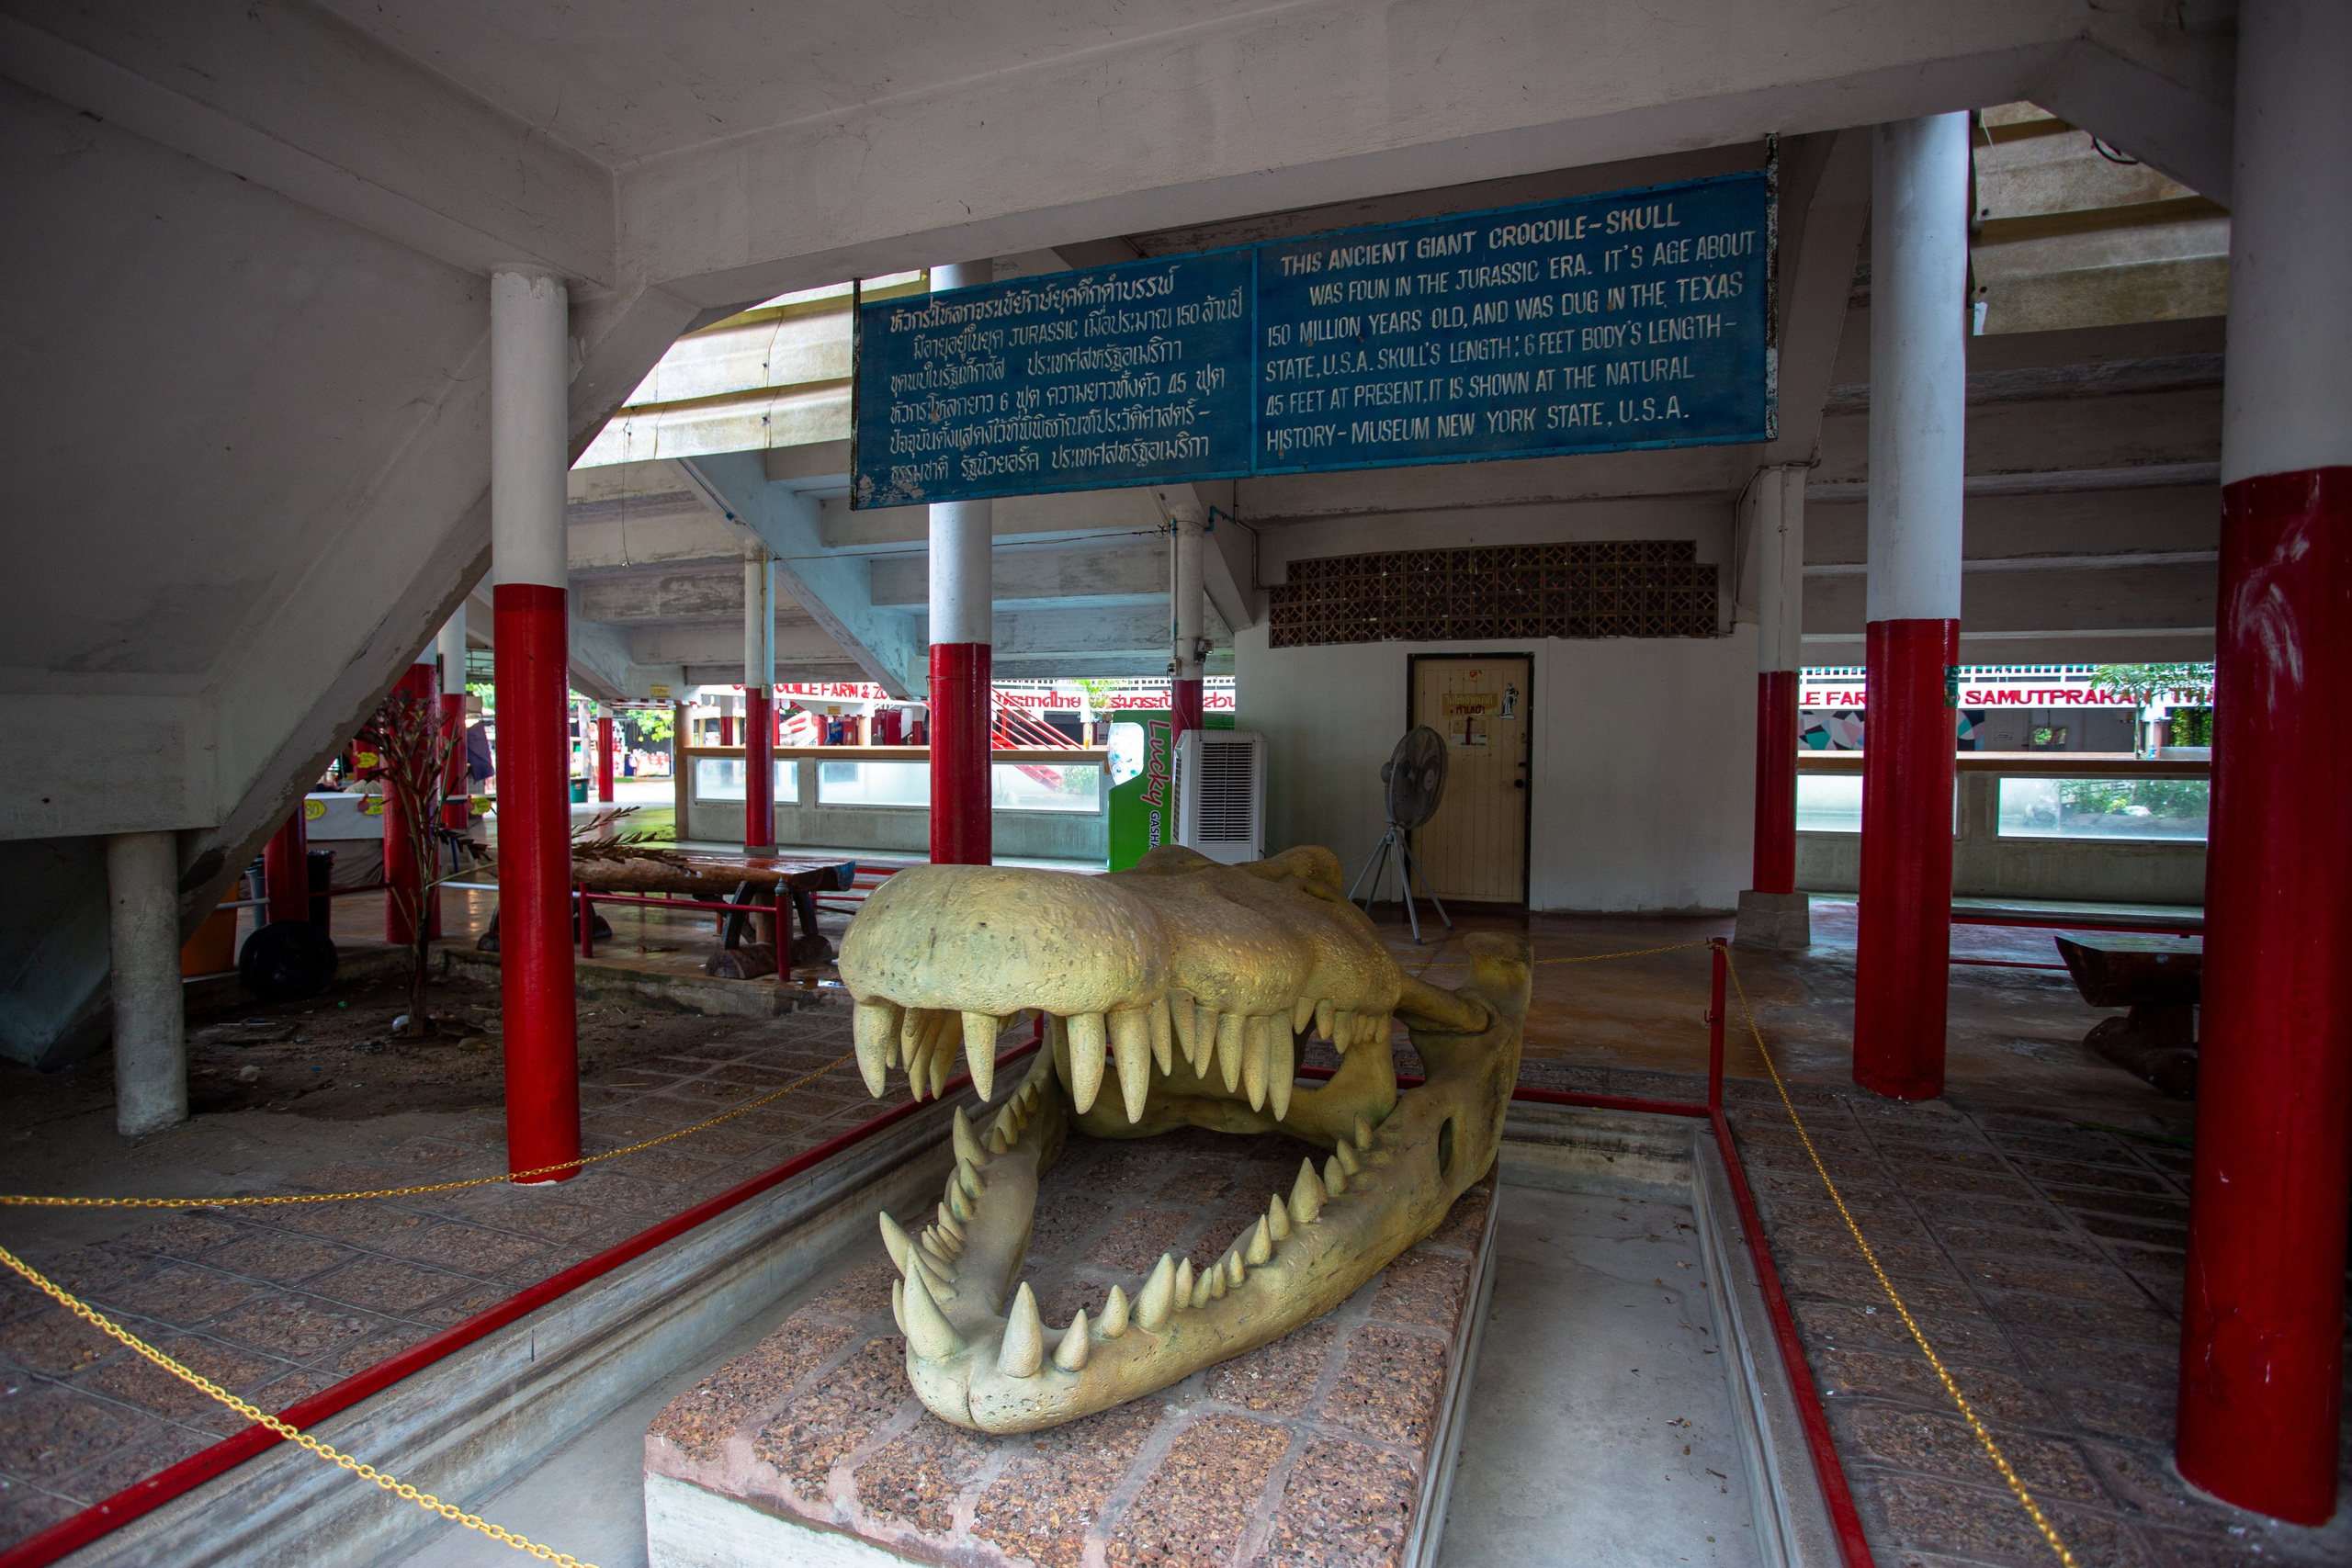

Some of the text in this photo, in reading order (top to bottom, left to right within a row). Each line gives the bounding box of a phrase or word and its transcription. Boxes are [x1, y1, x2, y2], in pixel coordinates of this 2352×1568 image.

[1281, 251, 1321, 276] THIS
[1328, 240, 1409, 271] ANCIENT
[1417, 231, 1477, 259] GIANT
[1309, 230, 1756, 307] WAS FOUN IN THE JURASSIC ERA. IT'S AGE ABOUT
[1009, 319, 1078, 347] JURASSIC
[1177, 303, 1199, 327] 150
[1268, 323, 1291, 348] 150
[1299, 315, 1361, 344] MILLION
[1368, 309, 1422, 335] YEARS
[1431, 305, 1468, 329] OLD,
[1472, 299, 1509, 327] AND
[1515, 295, 1554, 321] WAS
[1562, 289, 1599, 317] DUG
[1608, 286, 1625, 311] IN
[1676, 271, 1743, 304] TEXAS
[1377, 342, 1441, 370] SKULL'S
[1524, 333, 1535, 356] 6
[1539, 329, 1576, 361] FEET
[1581, 320, 1643, 351] BODY'S
[1000, 392, 1009, 412] 6
[1016, 385, 1040, 415] ฟุต
[1168, 372, 1186, 394] 45
[1196, 363, 1225, 396] ฟุต
[1265, 394, 1284, 416] 45
[1290, 389, 1325, 414] FEET
[1329, 387, 1350, 411] AT
[1429, 378, 1444, 402] IT
[1449, 376, 1463, 400] IS
[1468, 371, 1530, 399] SHOWN
[1535, 368, 1556, 393] AT
[1563, 365, 1597, 390] THE
[1606, 355, 1695, 387] NATURAL
[1438, 412, 1476, 438] NEW
[1487, 407, 1536, 434] YORK
[1547, 401, 1612, 430] STATE,
[1619, 395, 1690, 423] U.S.A.
[821, 683, 858, 698] FARM
[1826, 691, 1866, 705] FAR
[1140, 719, 1171, 807] Lucky
